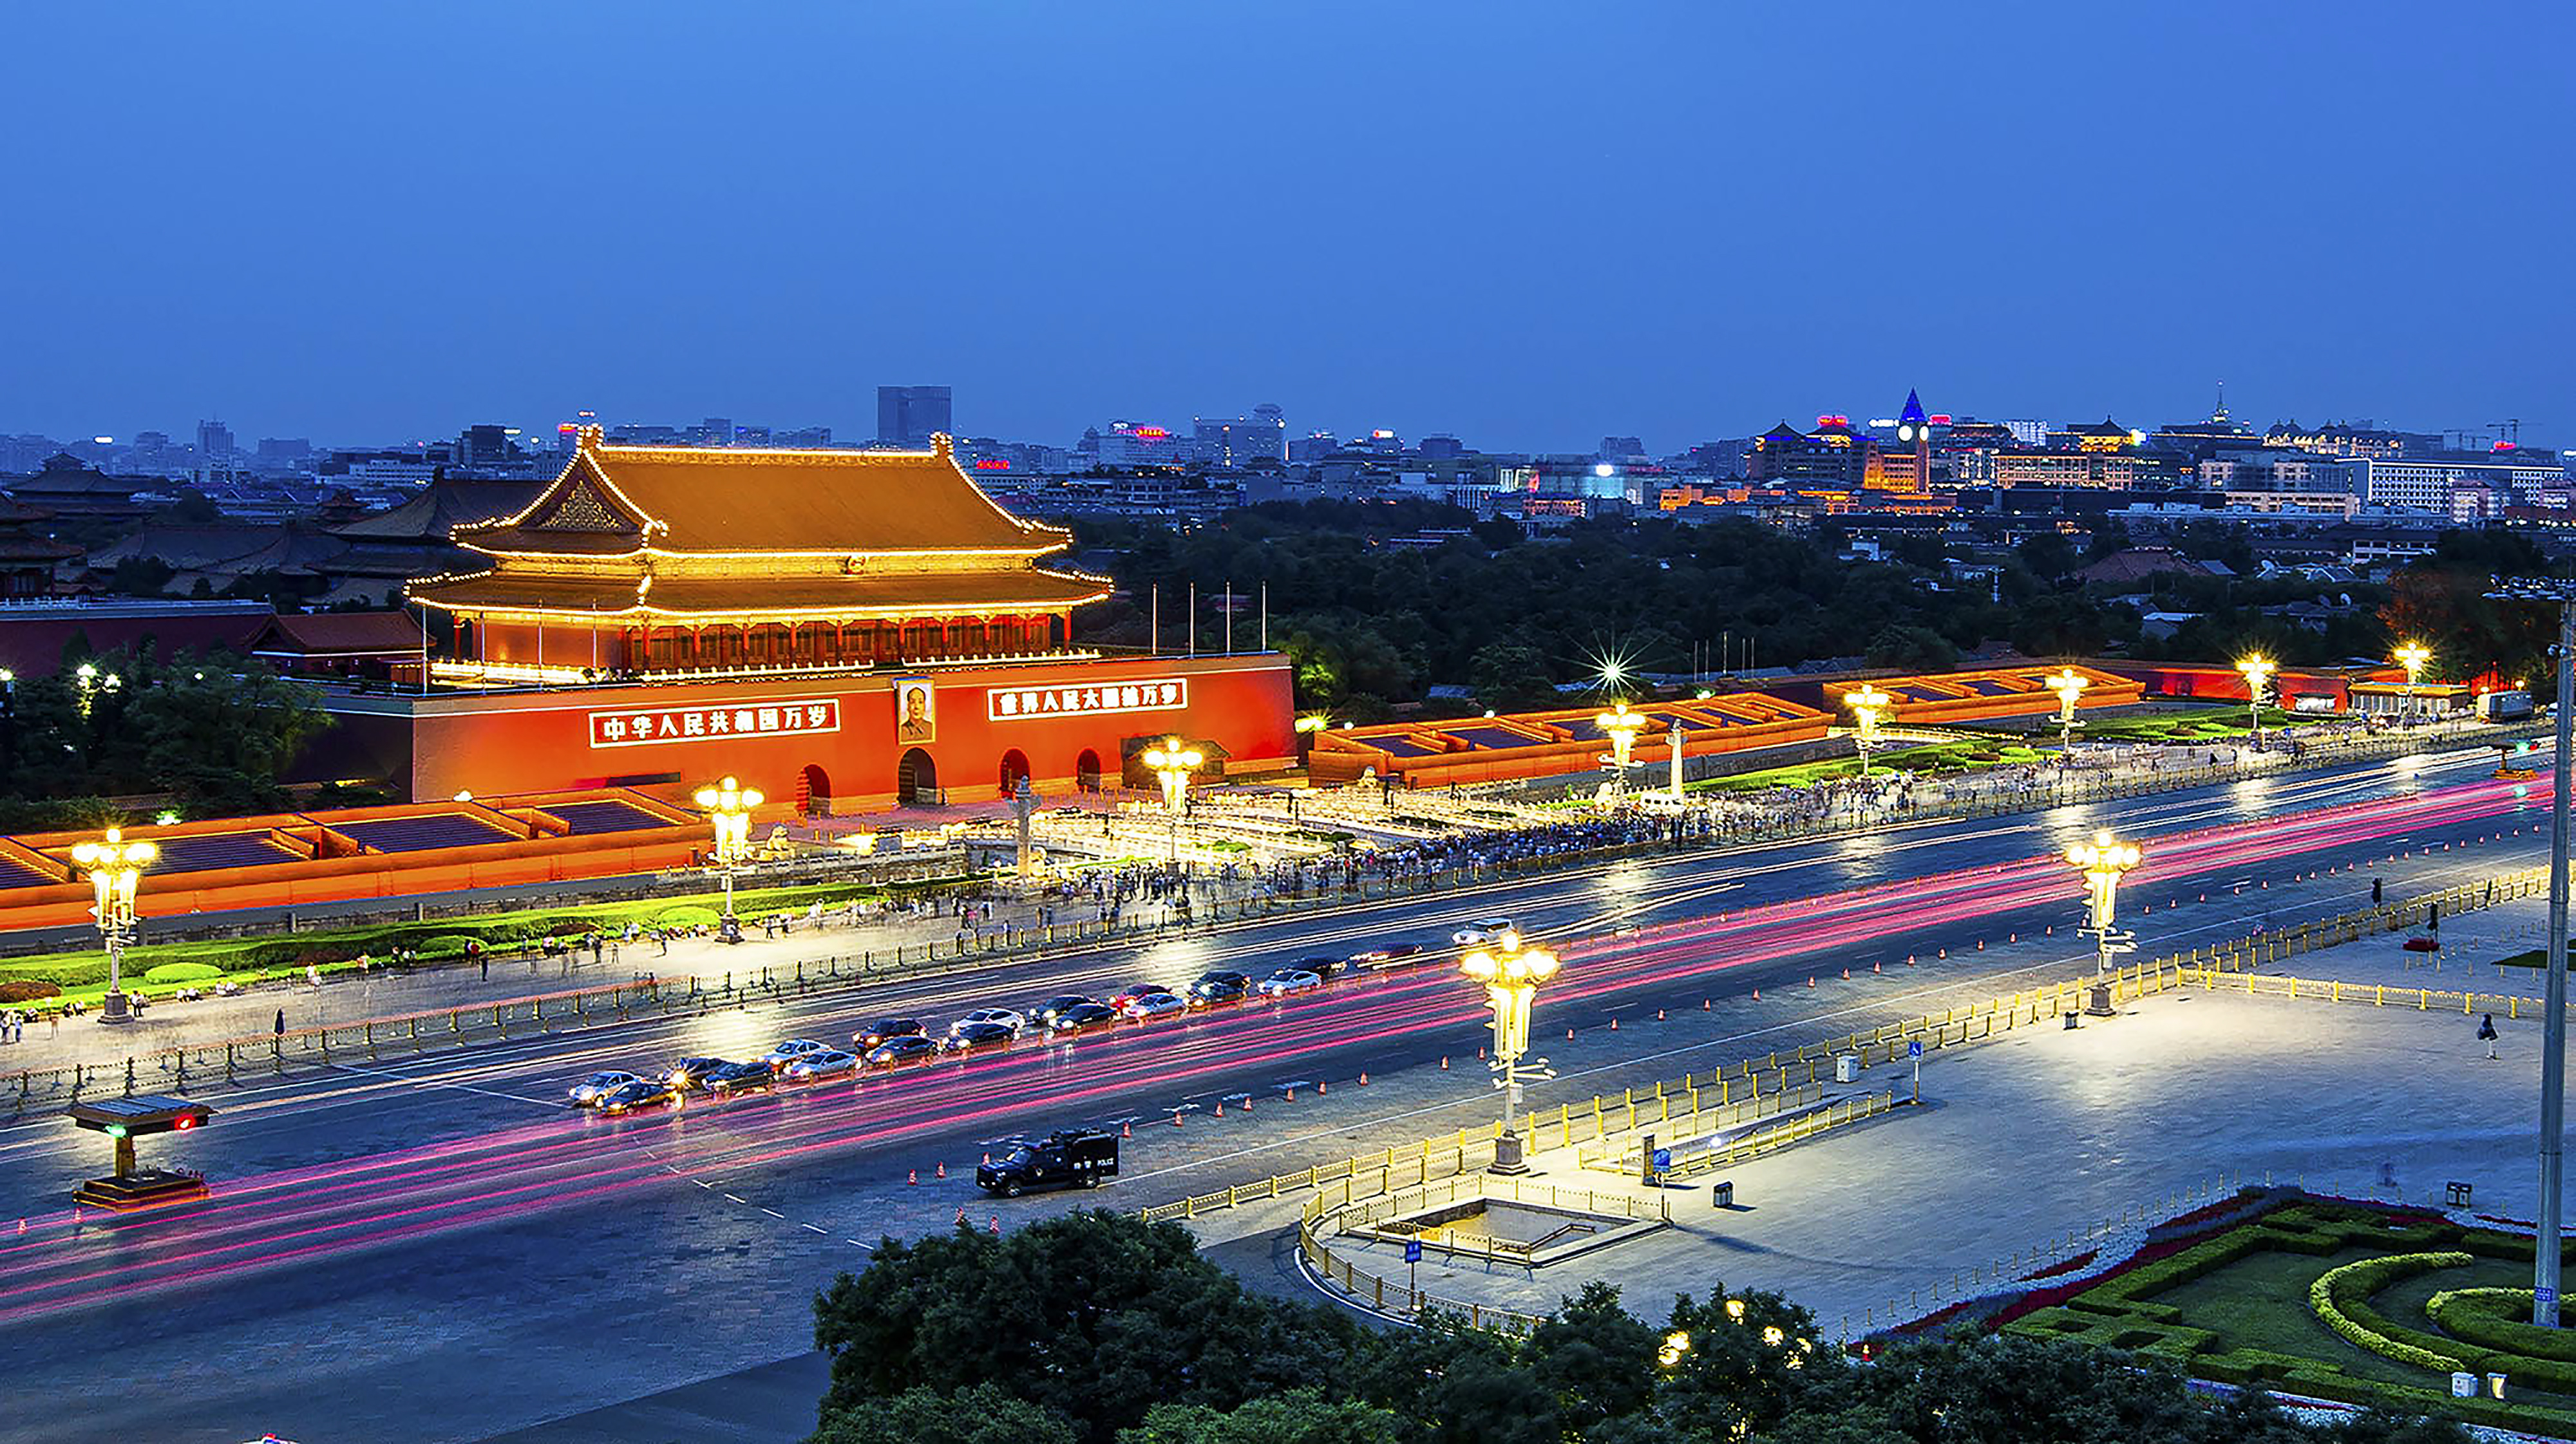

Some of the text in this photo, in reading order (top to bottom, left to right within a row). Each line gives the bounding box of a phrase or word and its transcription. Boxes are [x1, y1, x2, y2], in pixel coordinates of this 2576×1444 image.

[603, 705, 827, 741] 中华人民共和国万岁
